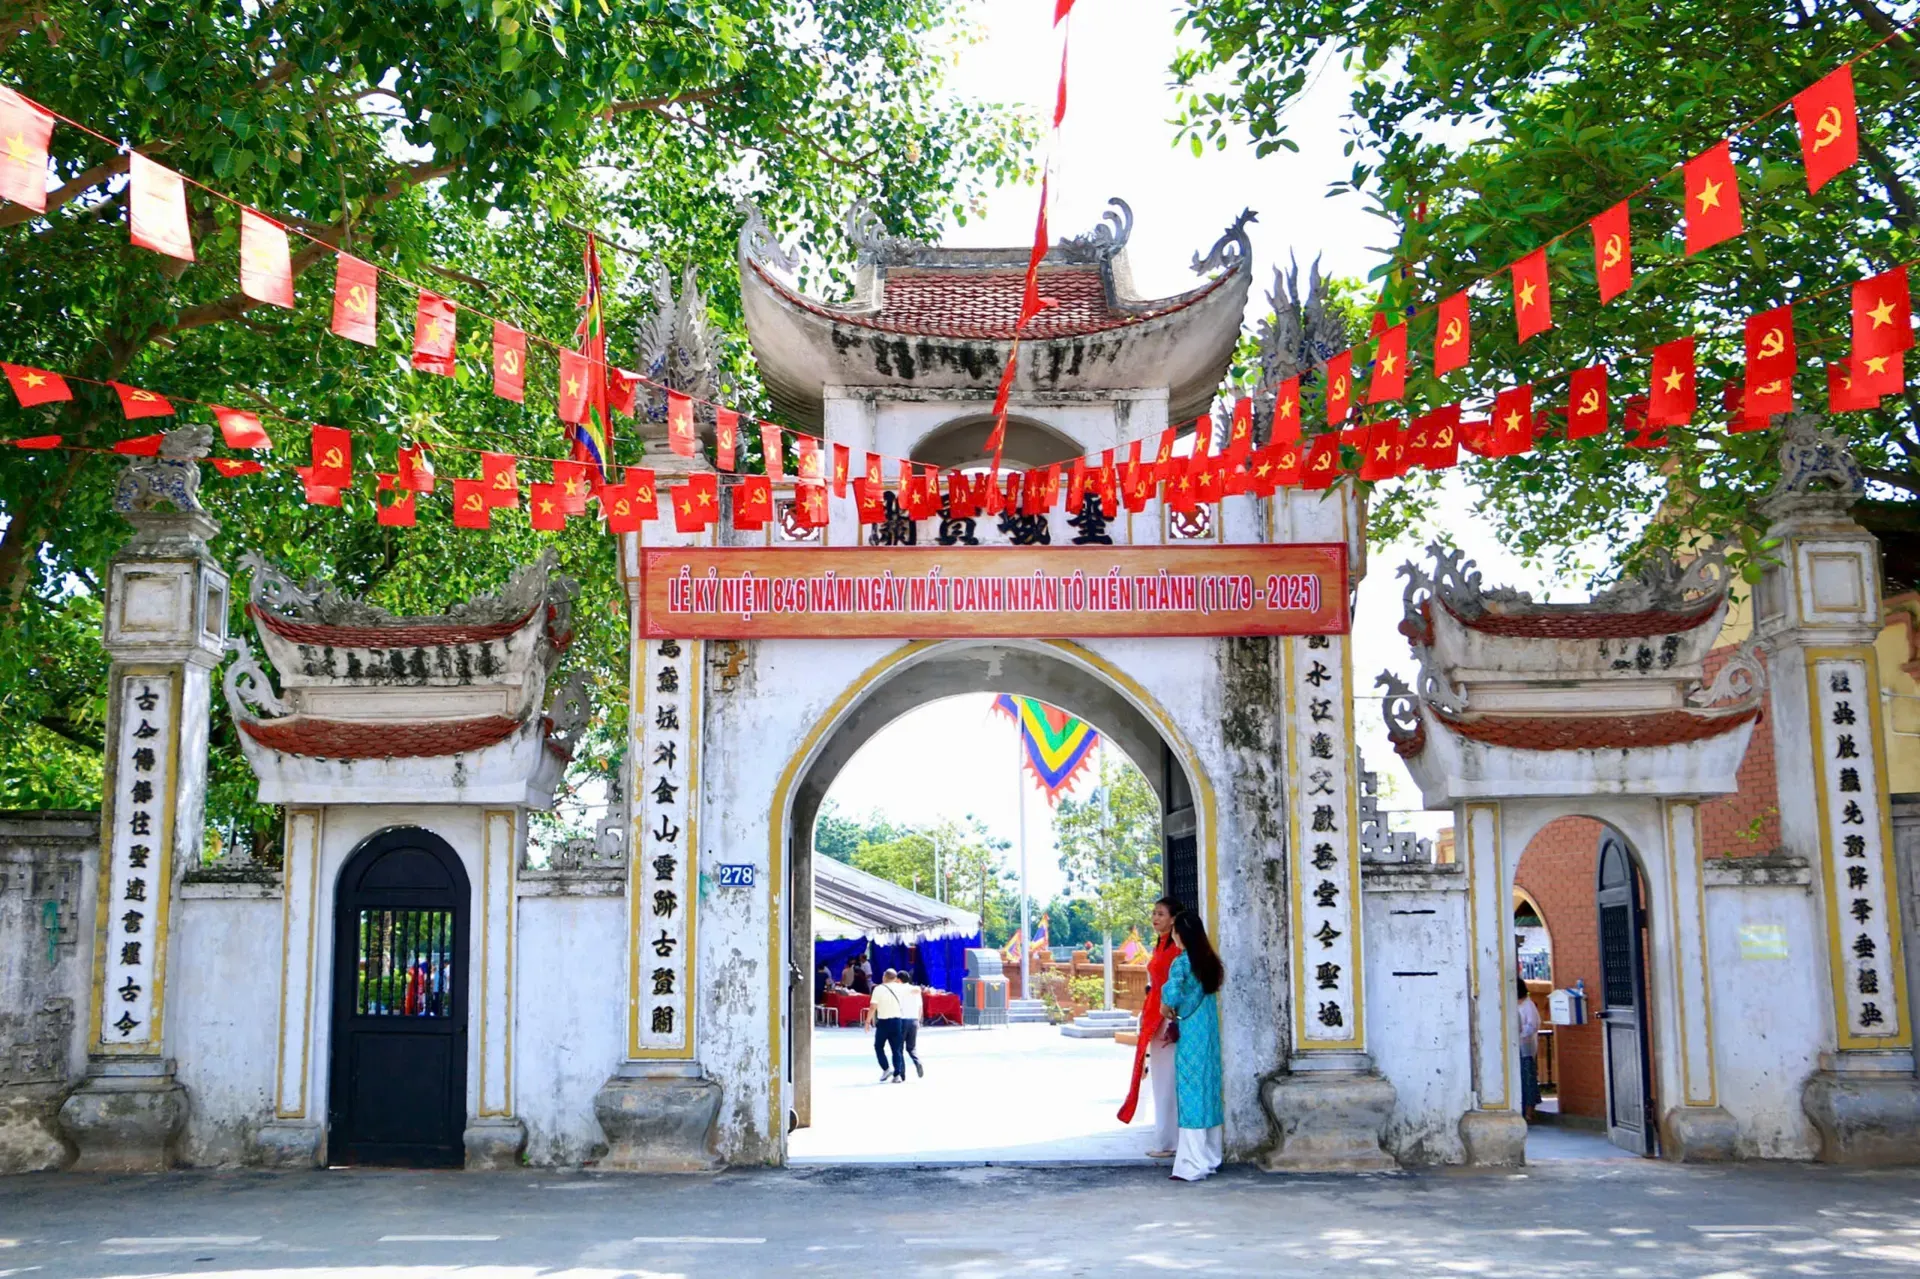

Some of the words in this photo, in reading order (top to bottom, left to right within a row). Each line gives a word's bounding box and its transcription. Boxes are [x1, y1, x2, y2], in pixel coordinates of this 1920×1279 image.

[669, 565, 691, 613] LỄ
[694, 566, 718, 613] KỶ
[721, 571, 769, 620] NIỆM
[774, 578, 807, 613] 846
[810, 571, 853, 613] NĂM
[857, 570, 906, 612] NGÀY
[910, 565, 949, 612] MẤT
[952, 577, 1003, 612] DANH
[1006, 569, 1058, 611] NHÂN
[1062, 569, 1085, 611] TÔ
[1088, 565, 1132, 611] HIẾN
[1135, 568, 1196, 611] THÀNH
[1200, 575, 1252, 614] (1179
[1255, 590, 1264, 599] -
[1267, 574, 1319, 614] 2025)
[721, 867, 753, 884] 278
